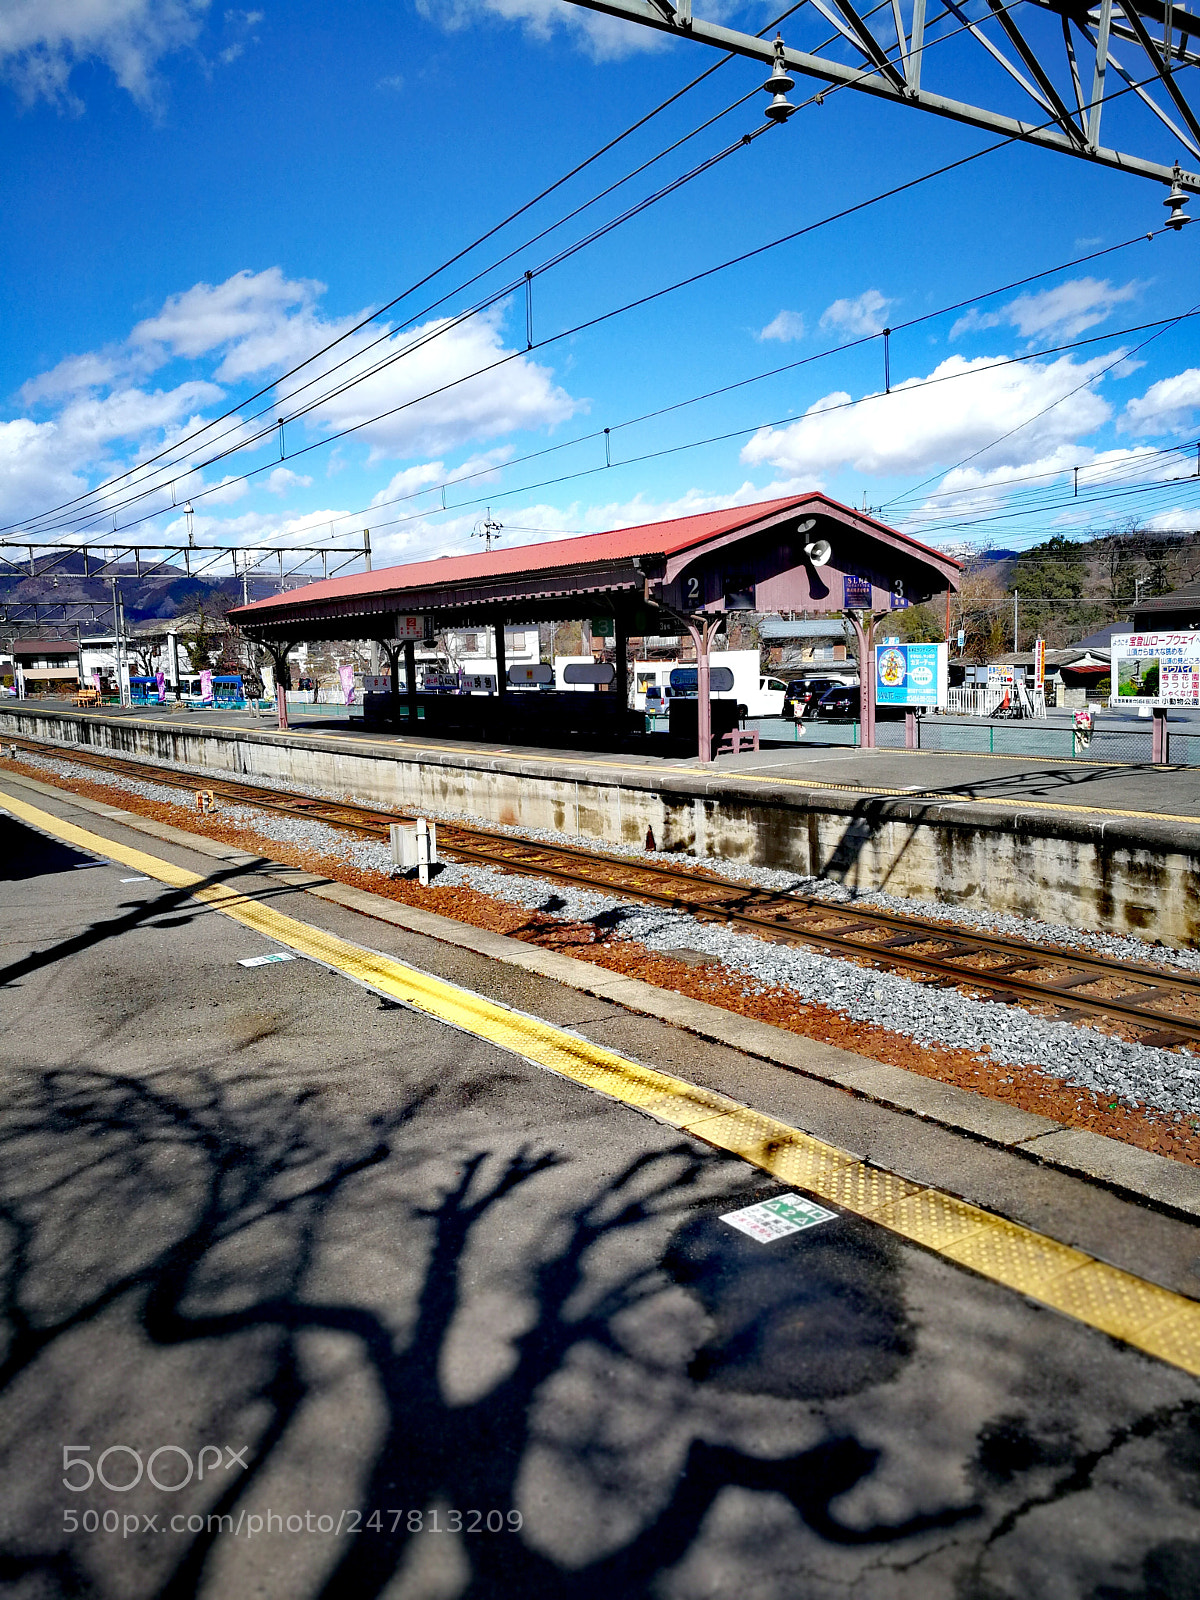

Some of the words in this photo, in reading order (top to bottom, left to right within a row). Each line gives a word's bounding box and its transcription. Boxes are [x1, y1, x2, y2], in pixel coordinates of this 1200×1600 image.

[687, 577, 700, 598] 2
[894, 579, 904, 598] 3
[408, 618, 415, 626] 2
[598, 619, 609, 633] 3
